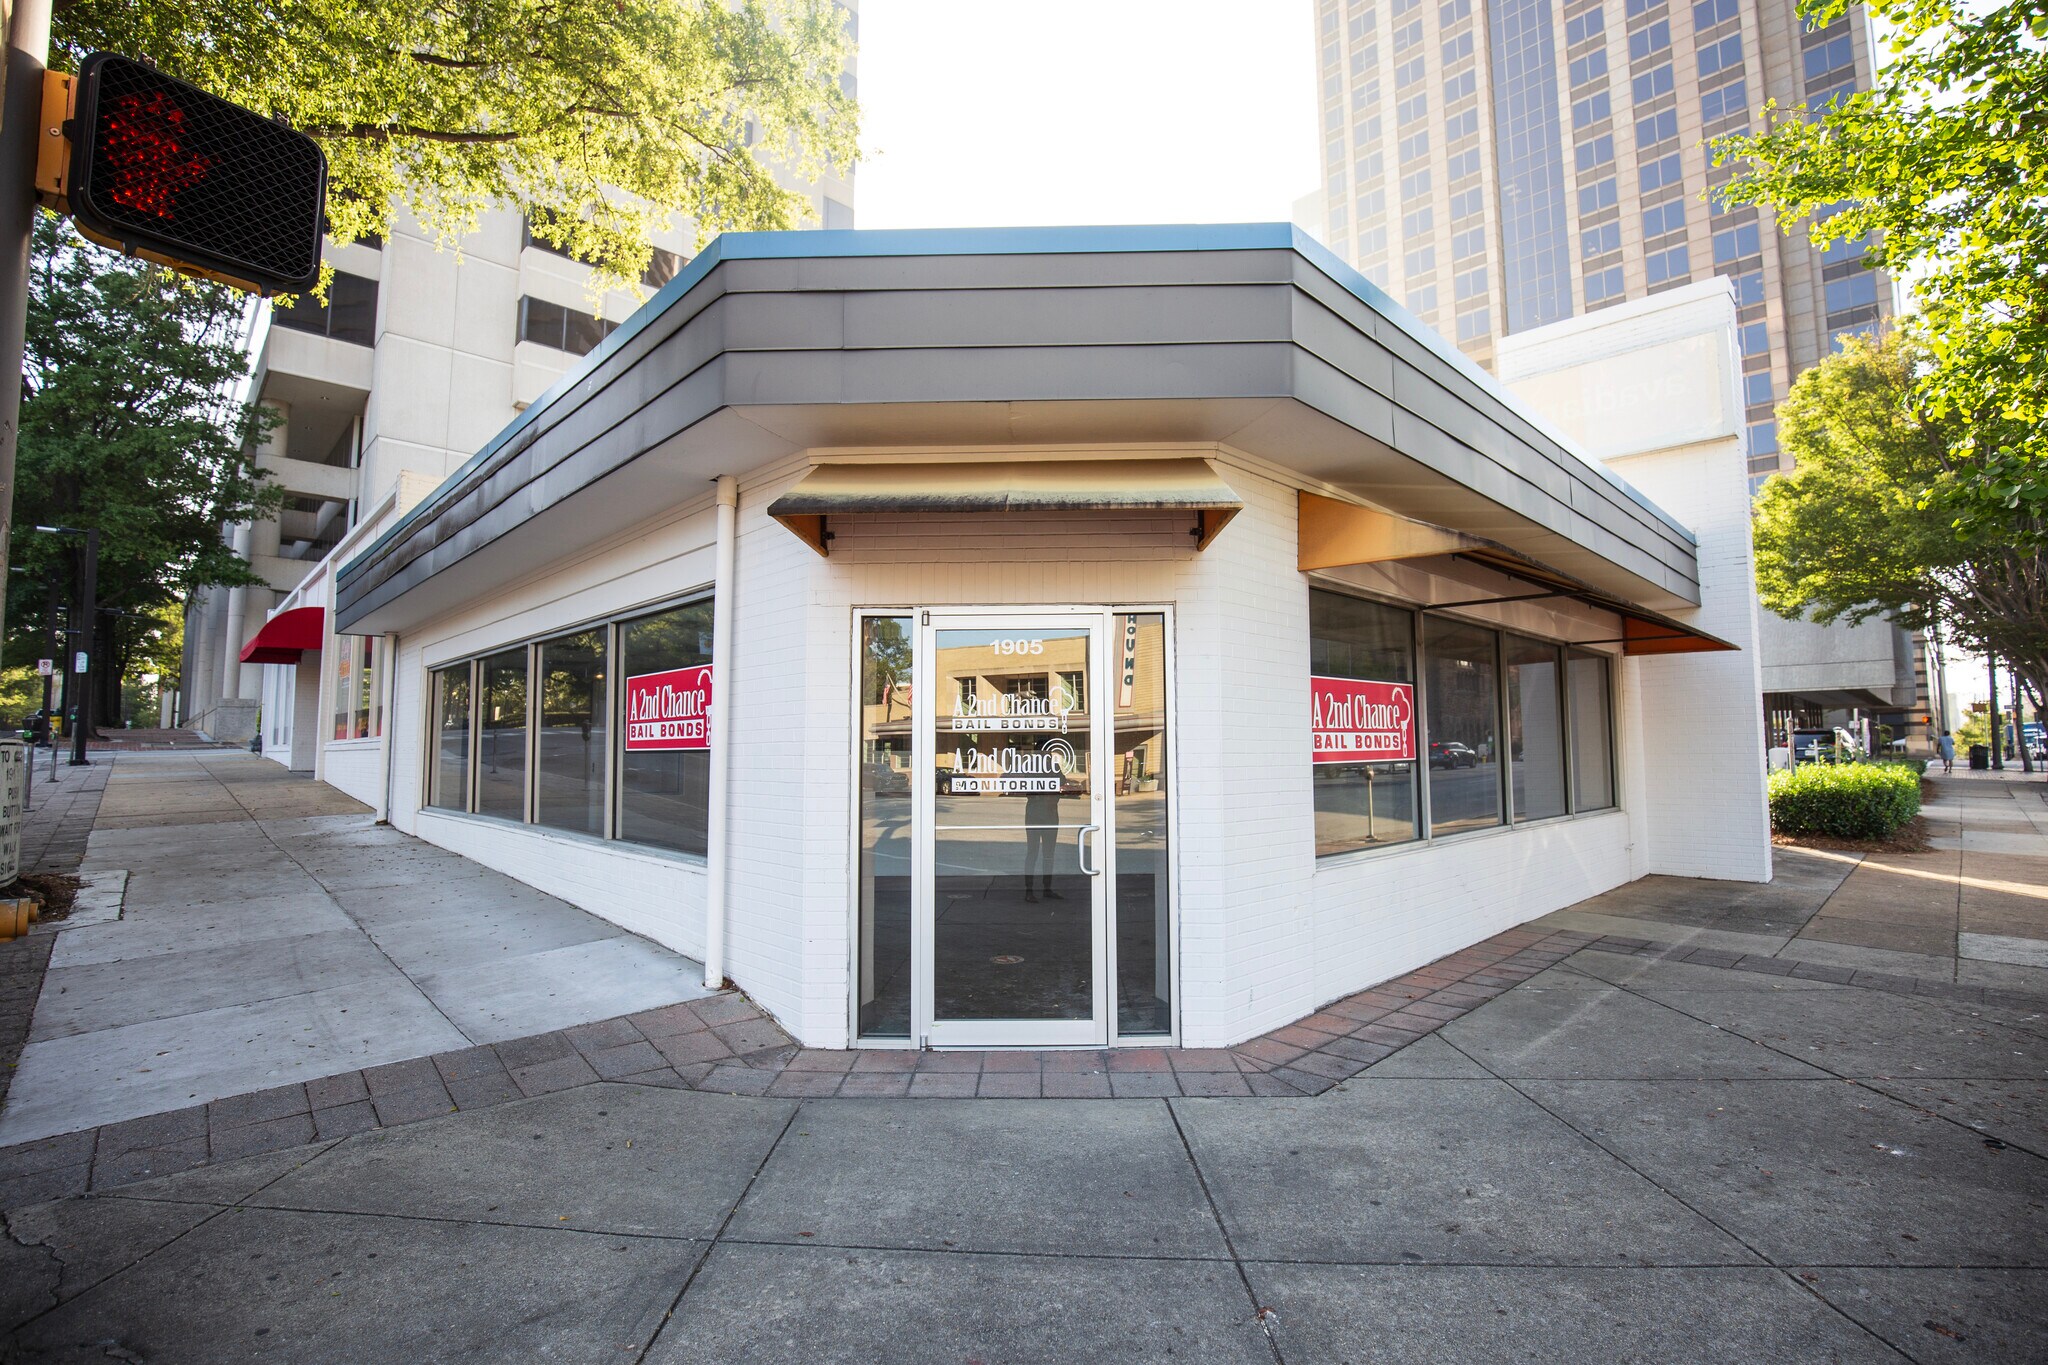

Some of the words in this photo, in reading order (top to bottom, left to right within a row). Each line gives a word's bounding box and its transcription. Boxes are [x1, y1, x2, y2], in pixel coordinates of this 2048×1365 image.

[990, 639, 1044, 655] 1905
[630, 689, 638, 721] A
[639, 686, 659, 720] 2nd
[661, 684, 705, 719] Chance
[953, 694, 964, 717] A
[967, 694, 997, 717] 2nd
[1001, 693, 1059, 717] Chance
[1312, 691, 1324, 729] A
[1325, 692, 1353, 729] 2nd
[1354, 694, 1400, 729] Chance
[631, 725, 654, 738] BAIL
[660, 722, 703, 738] BONDS
[955, 719, 991, 729] BAIL
[1001, 719, 1057, 729] BONDS
[1314, 734, 1347, 749] BAIL
[1355, 734, 1399, 749] BONDS
[1, 750, 11, 763] TO
[953, 748, 964, 774] A
[967, 748, 997, 774] 2nd
[1002, 747, 1061, 774] Chance
[955, 780, 1058, 791] MONITORING
